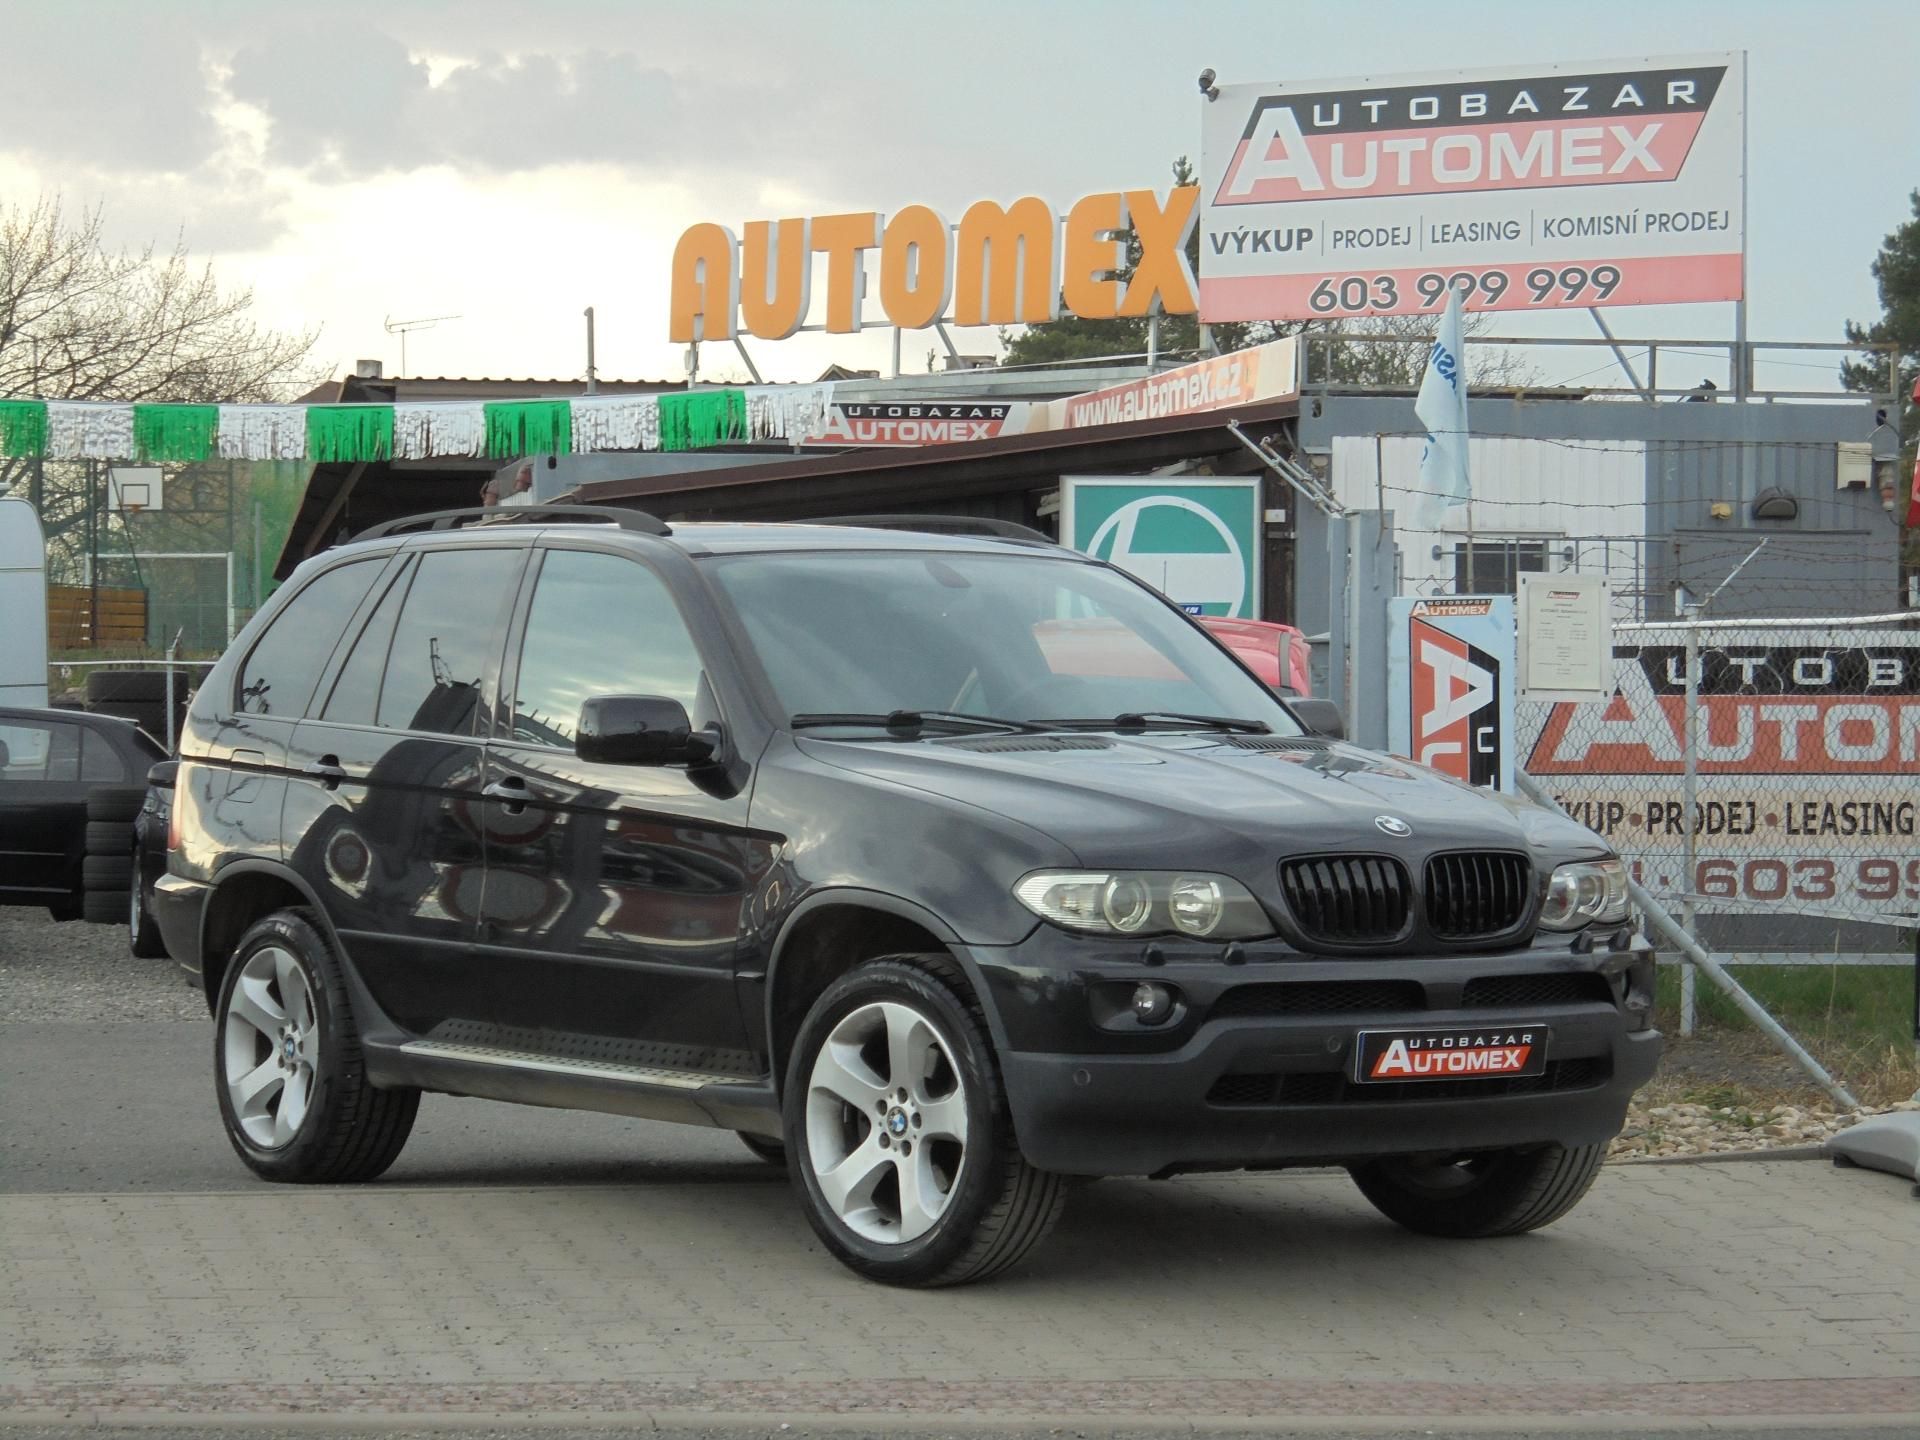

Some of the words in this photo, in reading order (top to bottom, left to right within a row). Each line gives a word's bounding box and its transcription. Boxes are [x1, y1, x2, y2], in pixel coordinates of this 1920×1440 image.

[1228, 106, 1664, 196] AUTOMEX
[1210, 225, 1314, 256] VÝKUP
[1333, 226, 1412, 249] PRODEJ
[1431, 219, 1521, 244] LEASING
[1543, 208, 1638, 239] KOMISNÍ
[1645, 210, 1730, 235] PRODEJ
[670, 186, 1200, 343] AUTOMEX
[1308, 275, 1399, 312] 603
[1416, 269, 1510, 309] 999
[1526, 264, 1622, 304] 999
[1074, 363, 1242, 428] www.automex.cz
[813, 404, 992, 441] AUTOMEX
[1412, 601, 1487, 616] AUTOMEX
[1551, 657, 1920, 763] AUTO
[1786, 802, 1914, 835] LEASING
[1696, 859, 1836, 900] 603
[1378, 1039, 1521, 1074] AUTOMEX
